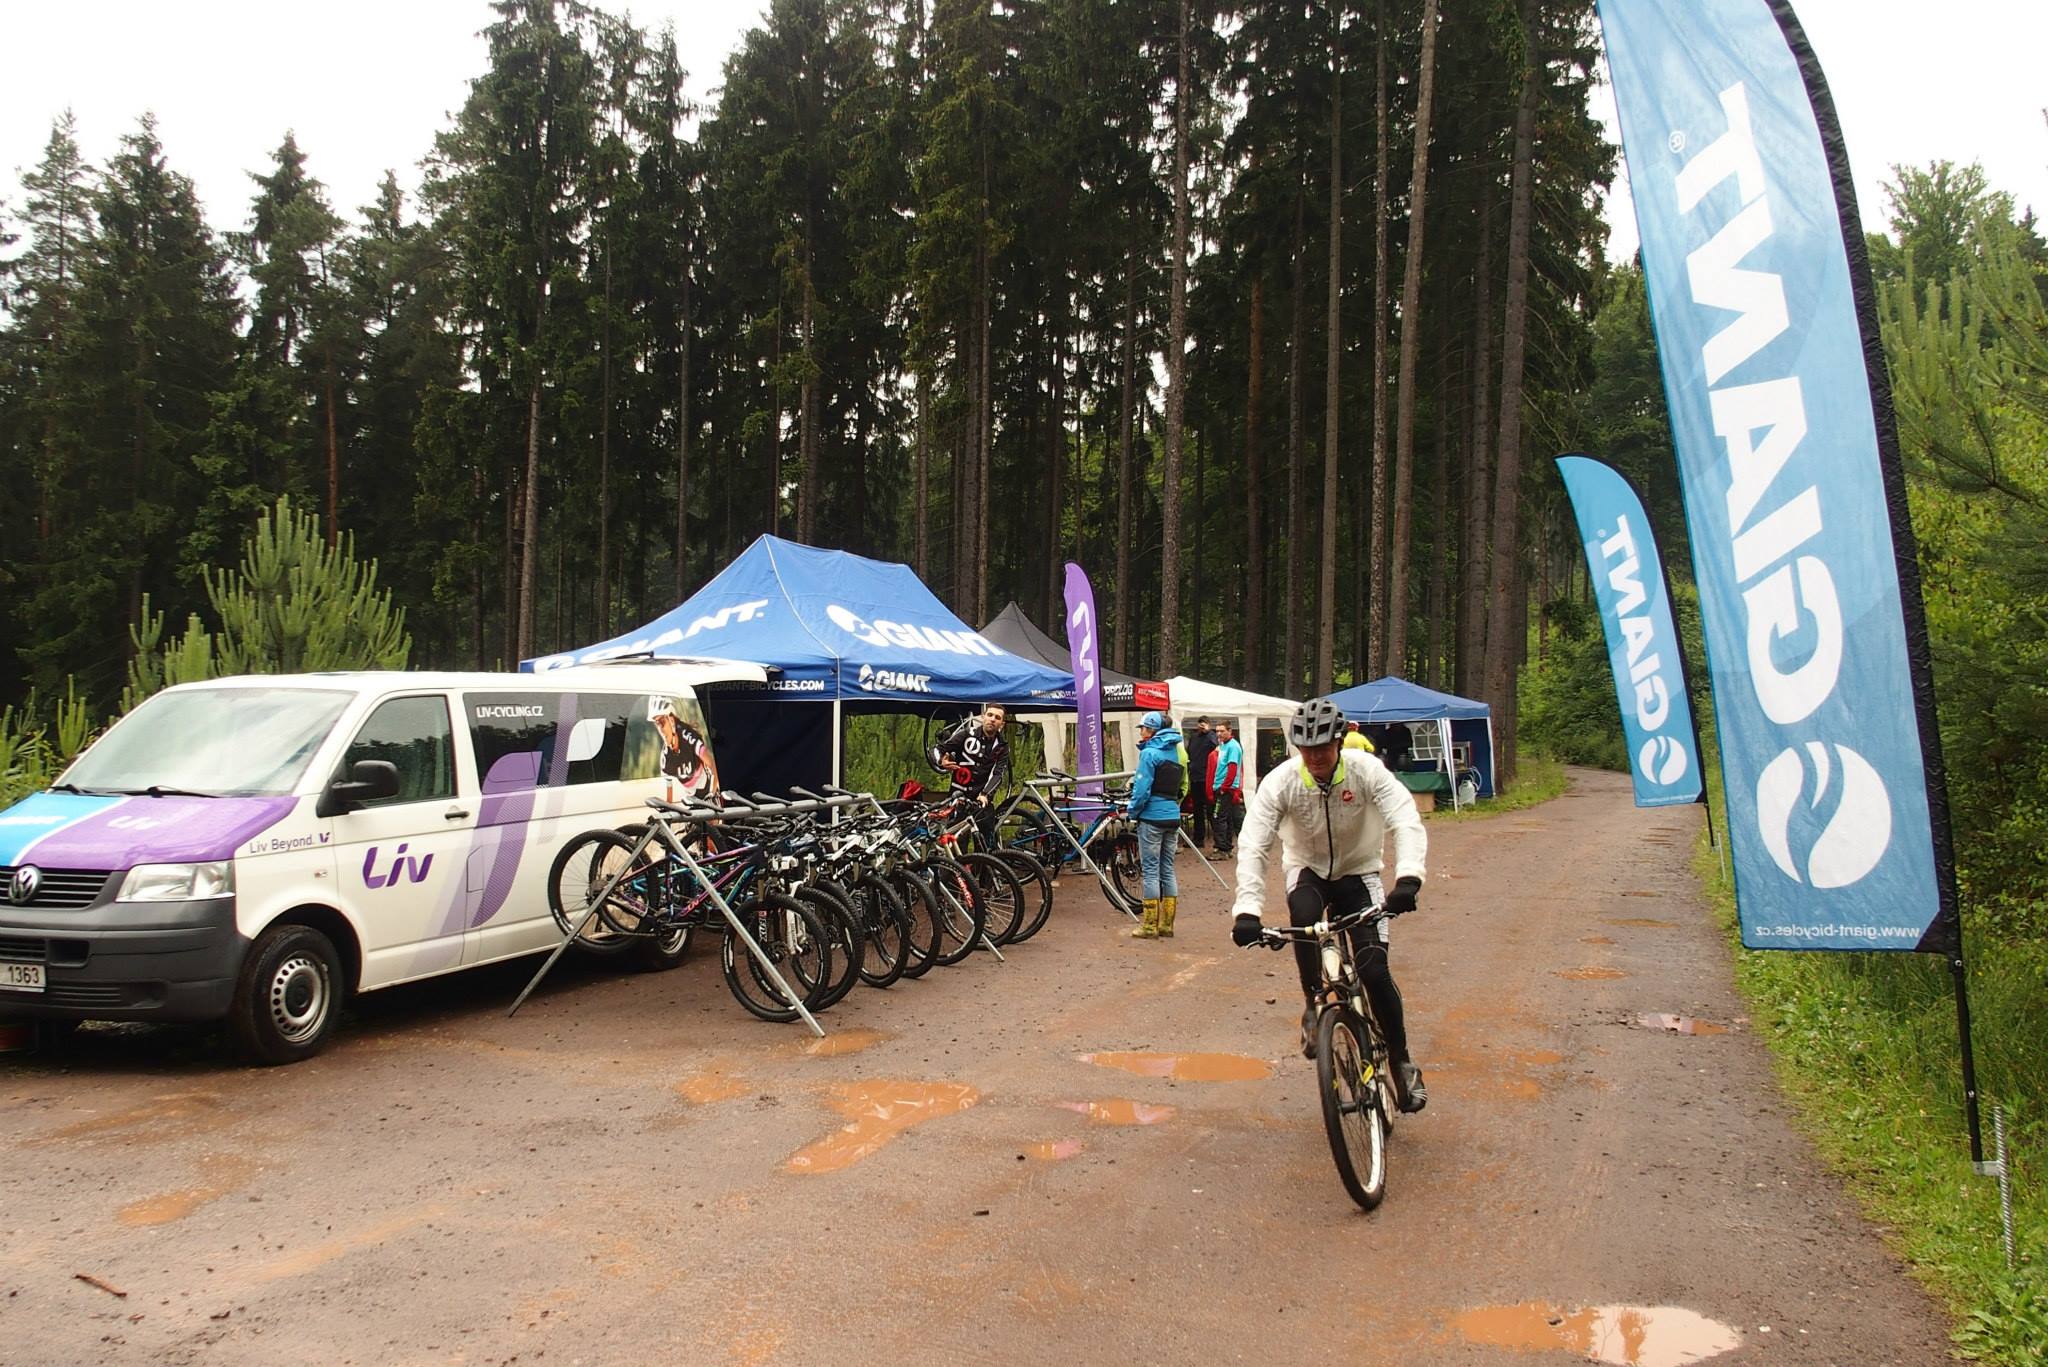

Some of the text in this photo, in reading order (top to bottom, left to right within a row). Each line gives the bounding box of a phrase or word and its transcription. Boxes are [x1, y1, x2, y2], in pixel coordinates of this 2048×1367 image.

[476, 705, 545, 718] LIV-CYCLING.CZ
[250, 834, 312, 854] Liv Beyond
[362, 843, 434, 889] Liv
[8, 965, 40, 984] 1363
